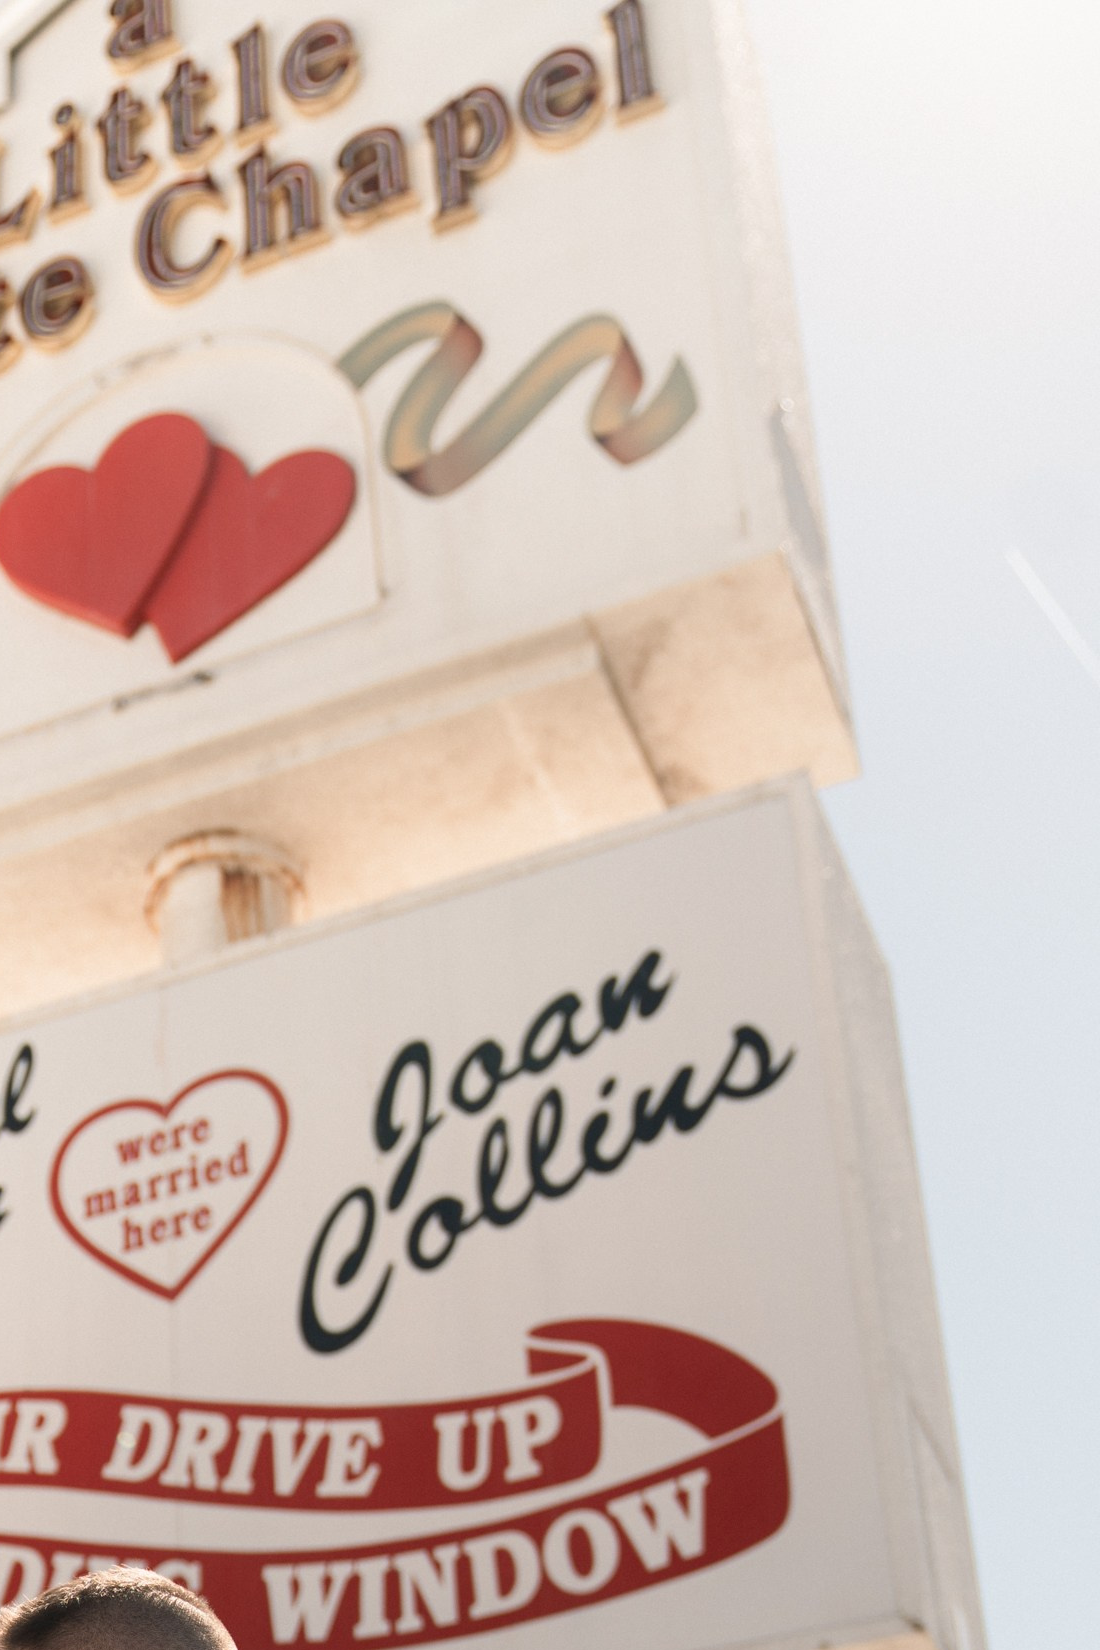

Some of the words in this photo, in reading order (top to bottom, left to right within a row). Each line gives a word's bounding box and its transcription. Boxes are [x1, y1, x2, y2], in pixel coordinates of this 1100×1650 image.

[105, 0, 178, 72] a
[134, 0, 666, 304] Chapel
[372, 948, 678, 1214] Joan
[82, 1140, 252, 1220] married
[116, 1112, 210, 1168] were
[296, 1022, 796, 1356] Collins
[120, 1200, 214, 1255] here
[102, 1401, 384, 1498] DRIVE
[433, 1393, 565, 1494] UP
[260, 1467, 712, 1647] WINDOW
